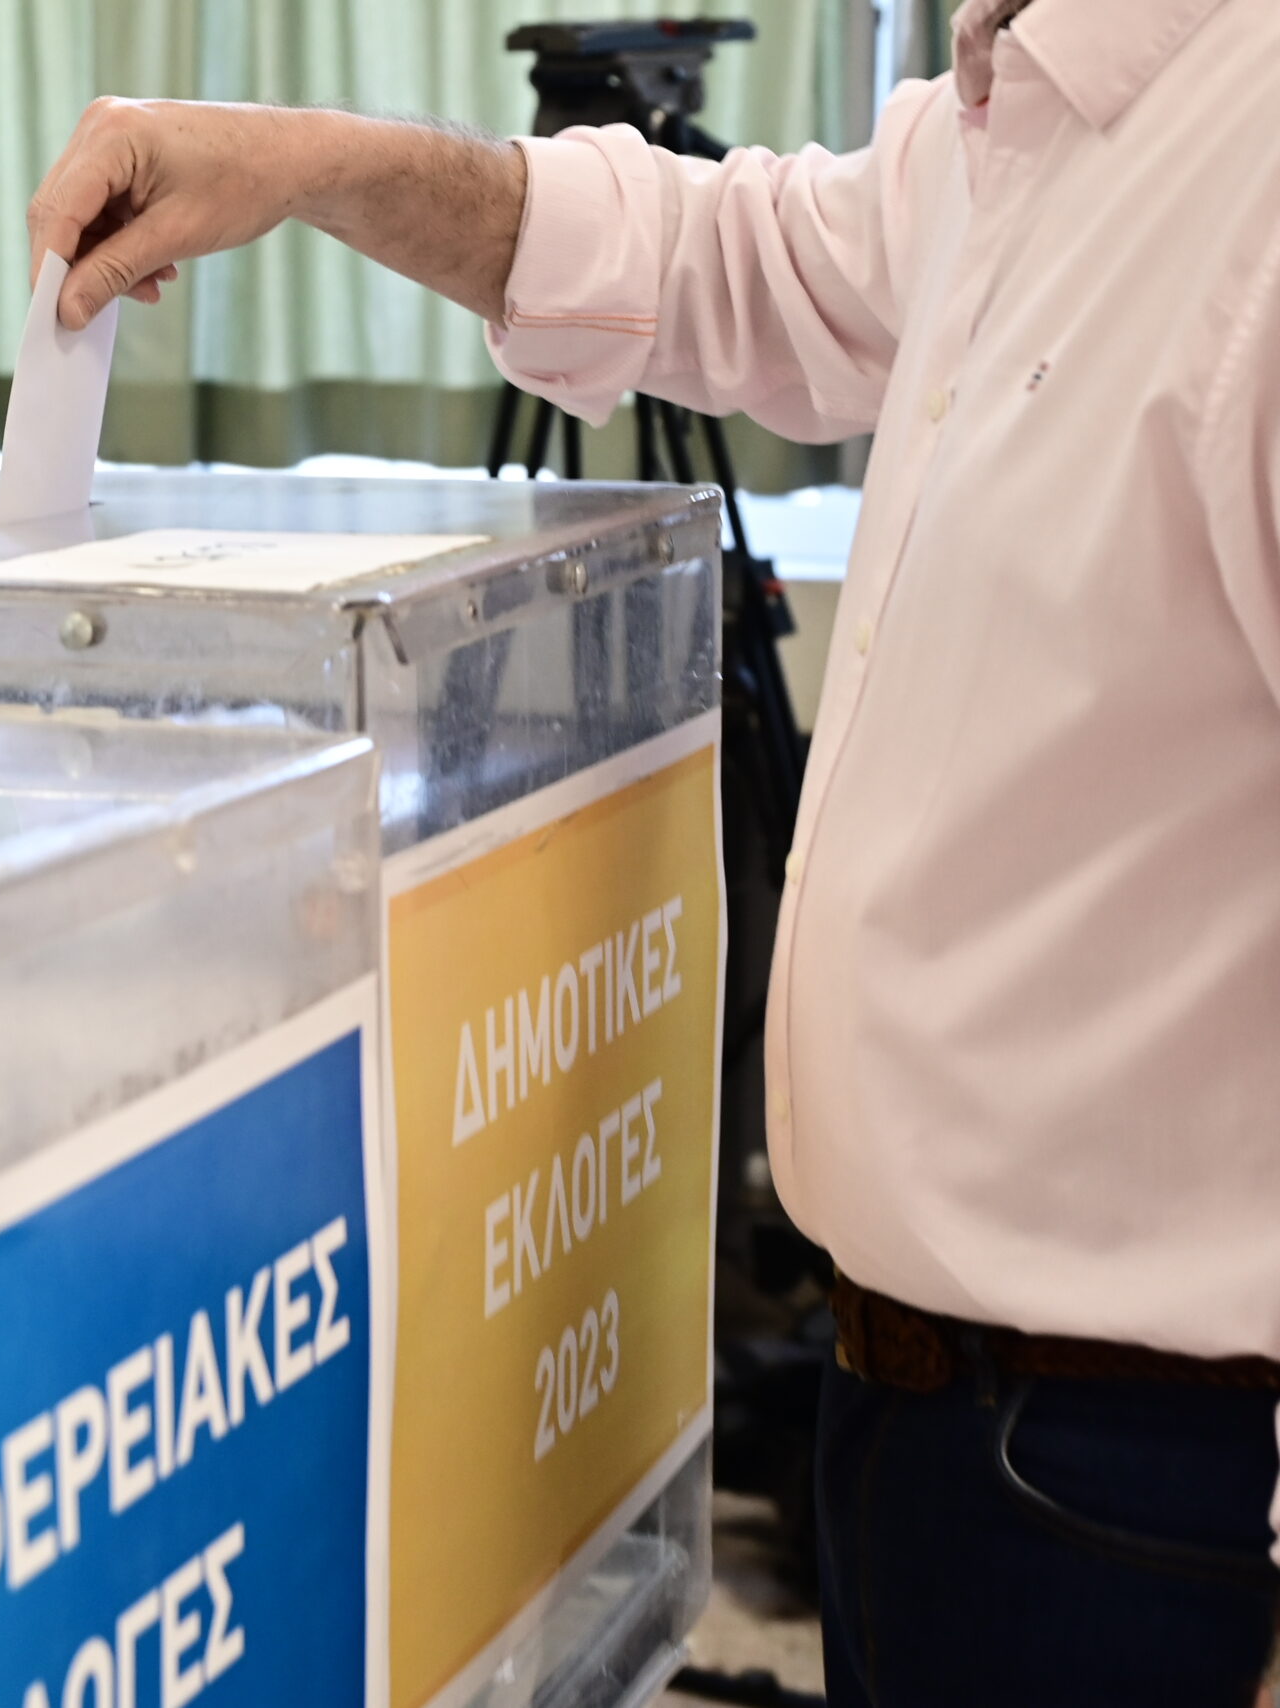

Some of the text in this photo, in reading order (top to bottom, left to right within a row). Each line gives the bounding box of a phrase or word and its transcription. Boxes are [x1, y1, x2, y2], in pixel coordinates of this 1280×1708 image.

[452, 895, 682, 1147] ΔΗΜΟΤΙΚΕΣ
[484, 1077, 662, 1320] ΕΚΛΟΓΕΣ
[533, 1288, 620, 1463] 2023
